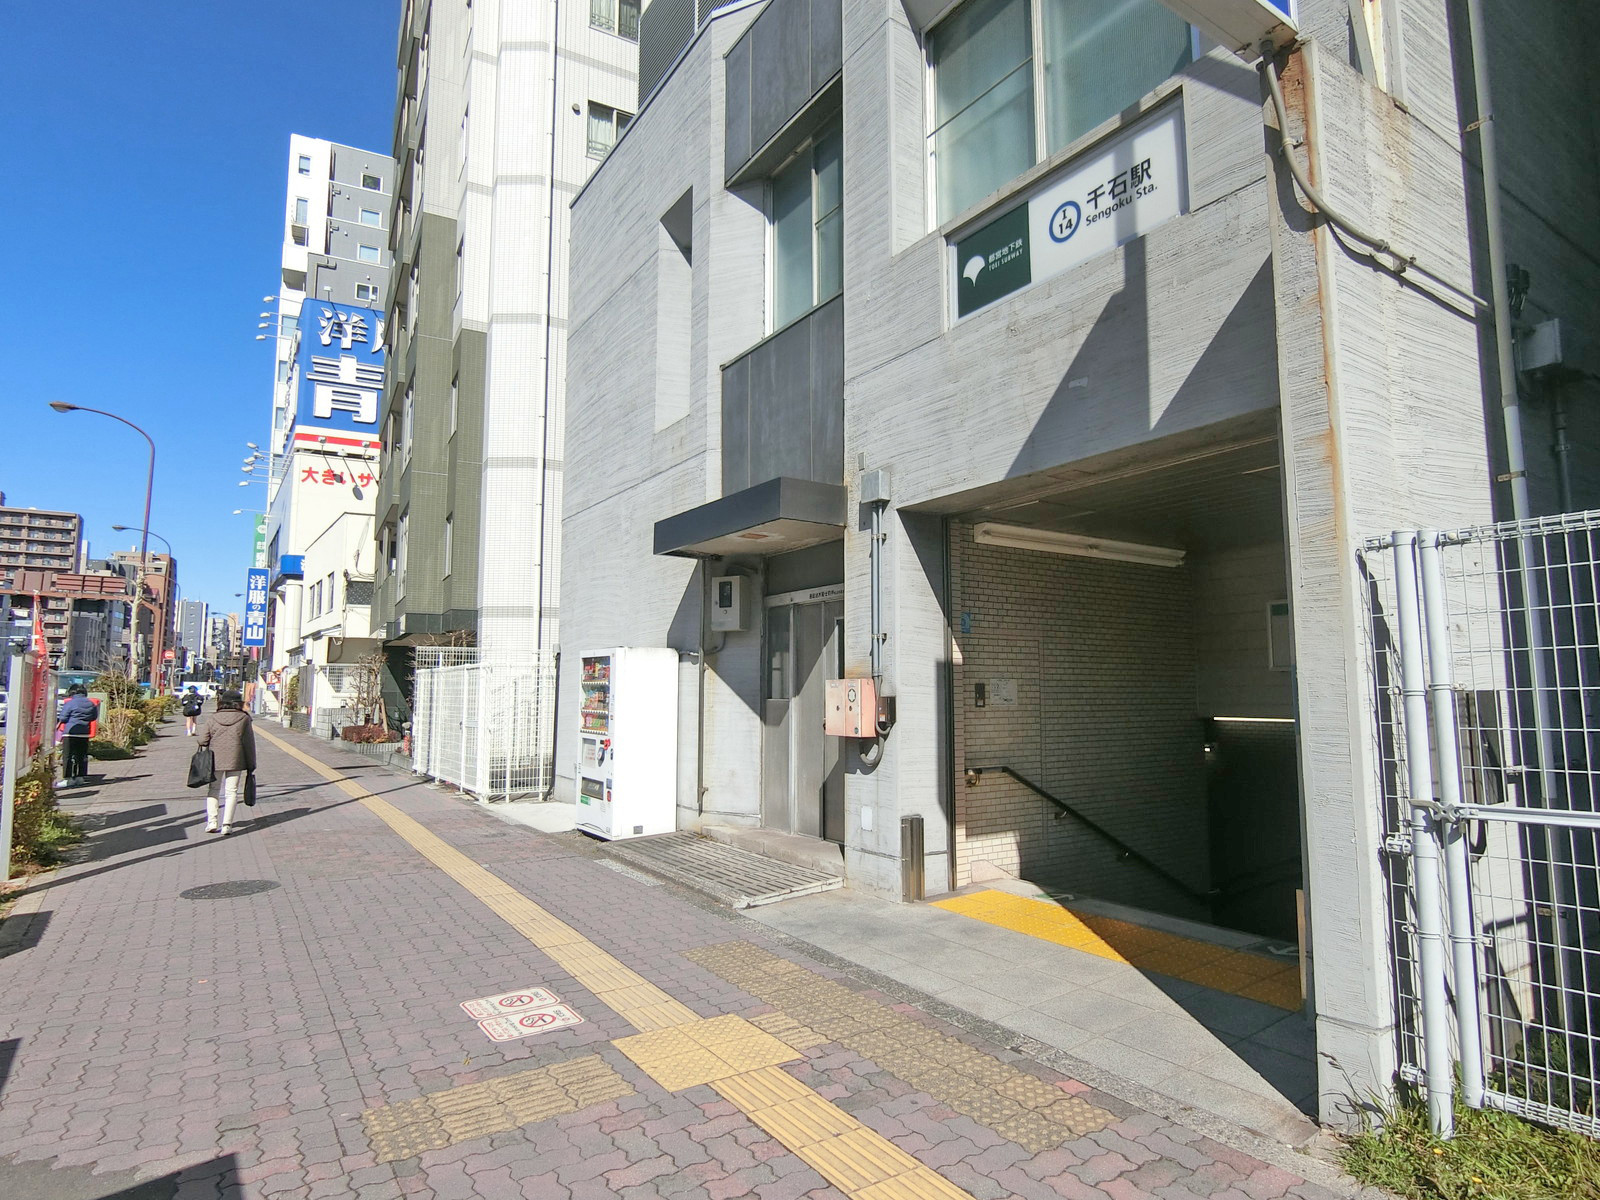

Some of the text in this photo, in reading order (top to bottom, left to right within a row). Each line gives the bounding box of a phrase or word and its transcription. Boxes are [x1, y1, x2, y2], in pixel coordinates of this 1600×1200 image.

[1085, 182, 1158, 227] Sengoku Sta.
[1086, 158, 1152, 210] 千石駅
[1058, 218, 1074, 235] 14
[1062, 208, 1067, 221] I
[317, 307, 385, 354] 洋
[246, 574, 267, 640] 洋服の青山
